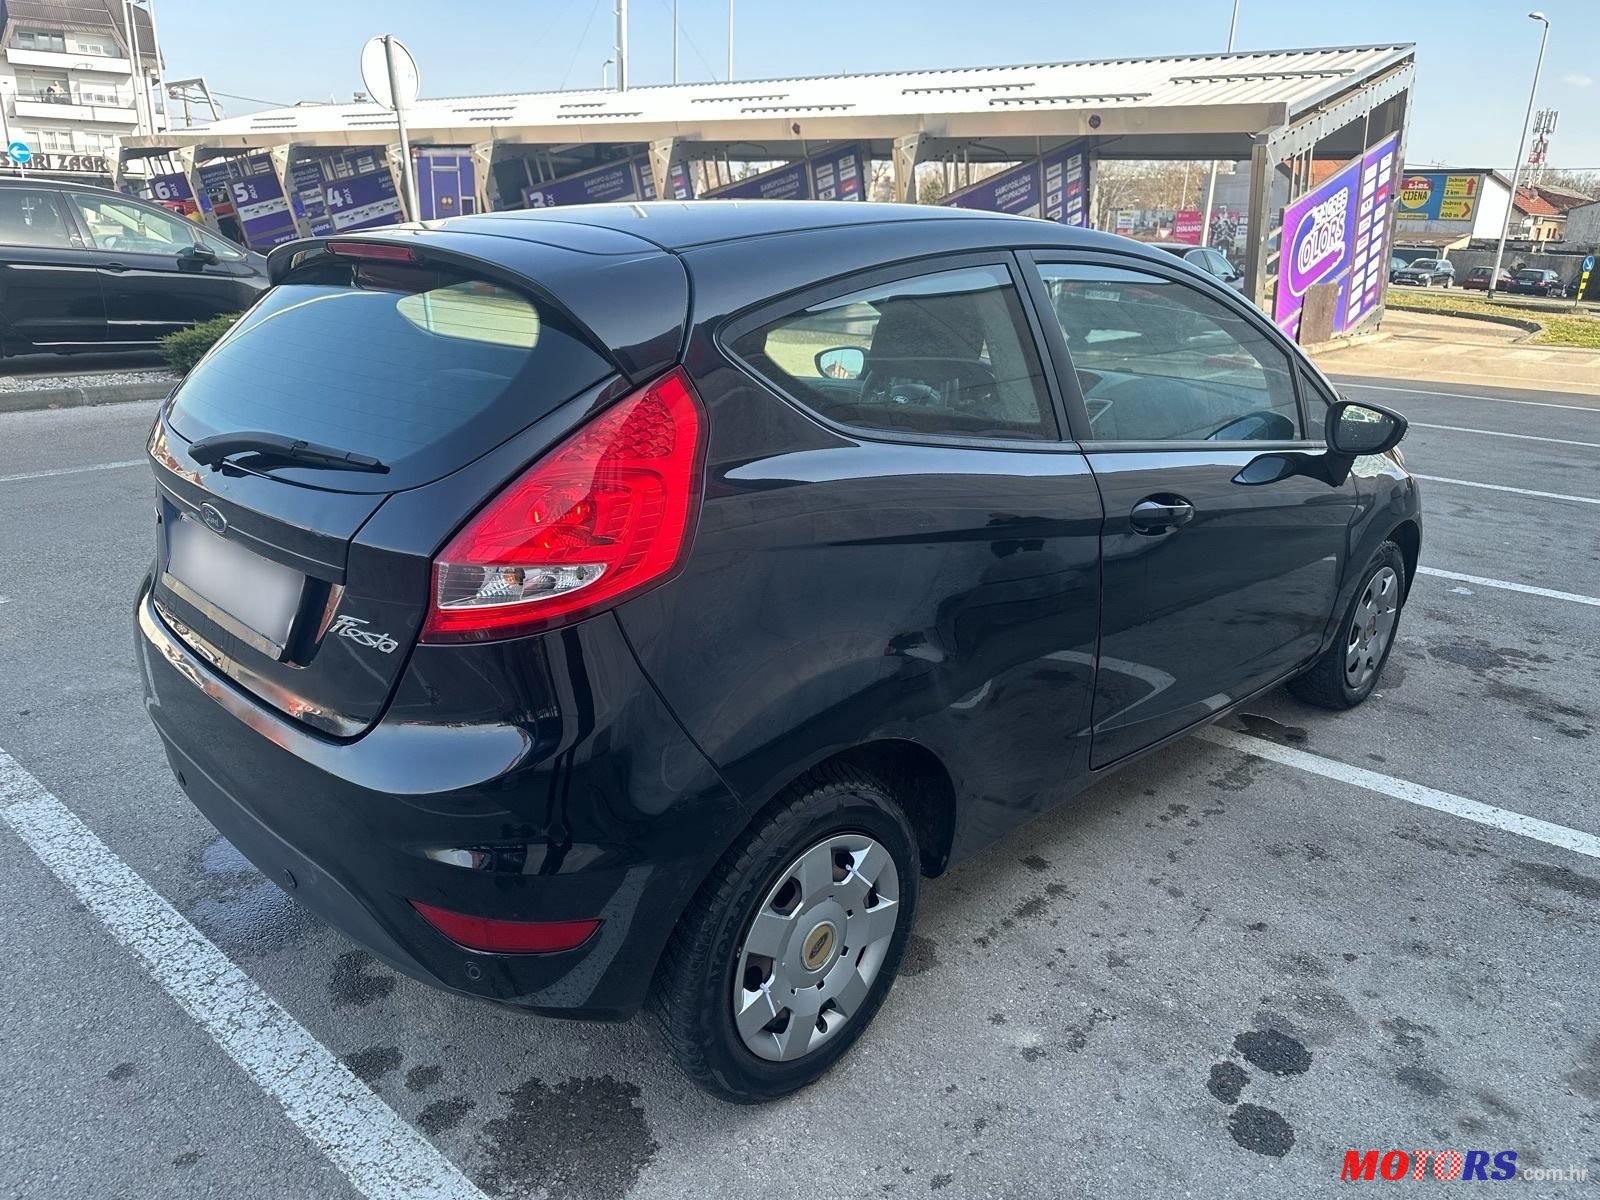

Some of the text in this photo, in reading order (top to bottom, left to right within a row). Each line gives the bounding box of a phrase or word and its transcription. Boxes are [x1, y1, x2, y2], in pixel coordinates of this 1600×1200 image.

[0, 152, 129, 173] SRI ZAGRB
[155, 182, 170, 199] 6
[233, 182, 249, 202] 5
[327, 188, 343, 207] 4
[1402, 191, 1428, 201] CIJENA
[328, 614, 399, 654] Fiesta
